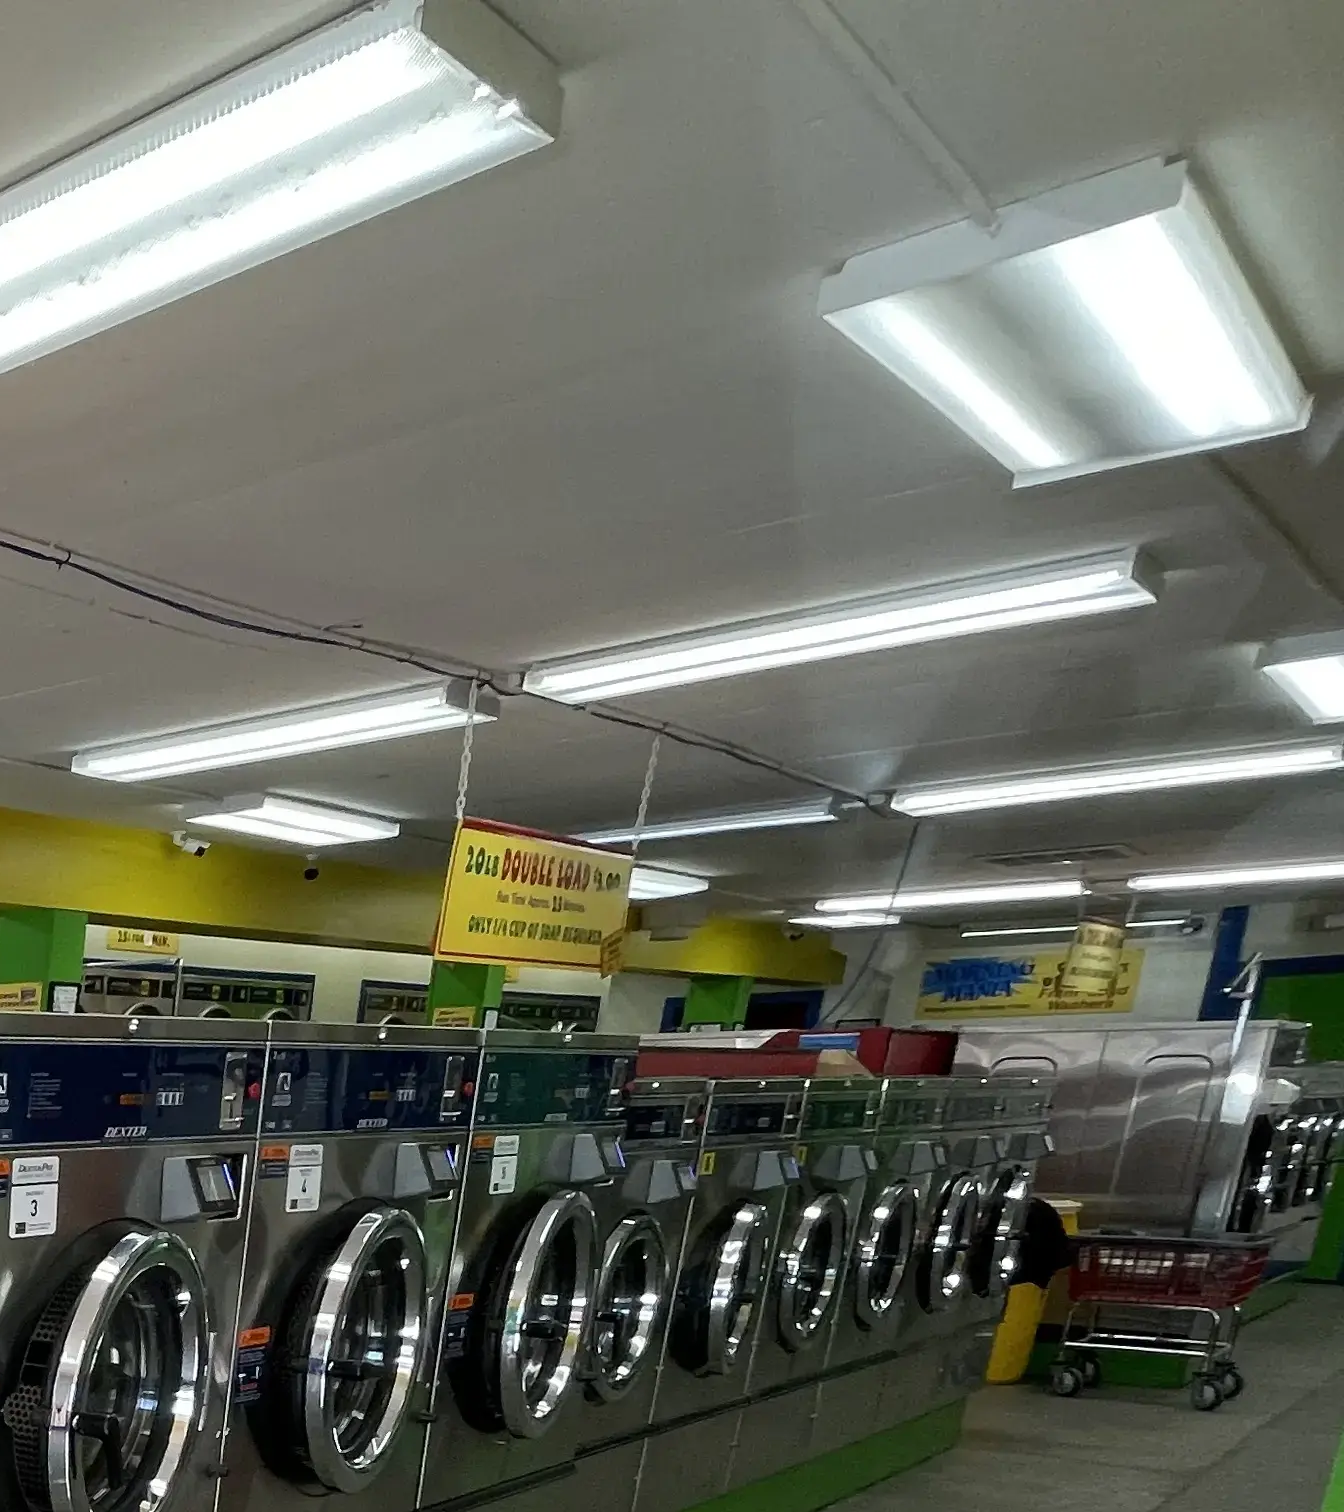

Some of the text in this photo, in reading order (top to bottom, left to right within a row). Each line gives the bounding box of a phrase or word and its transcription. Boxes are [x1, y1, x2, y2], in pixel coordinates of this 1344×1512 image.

[501, 848, 555, 887] DOUBLE
[556, 859, 590, 892] LOAD
[104, 1126, 147, 1138] DEXTER
[30, 1199, 39, 1217] 3
